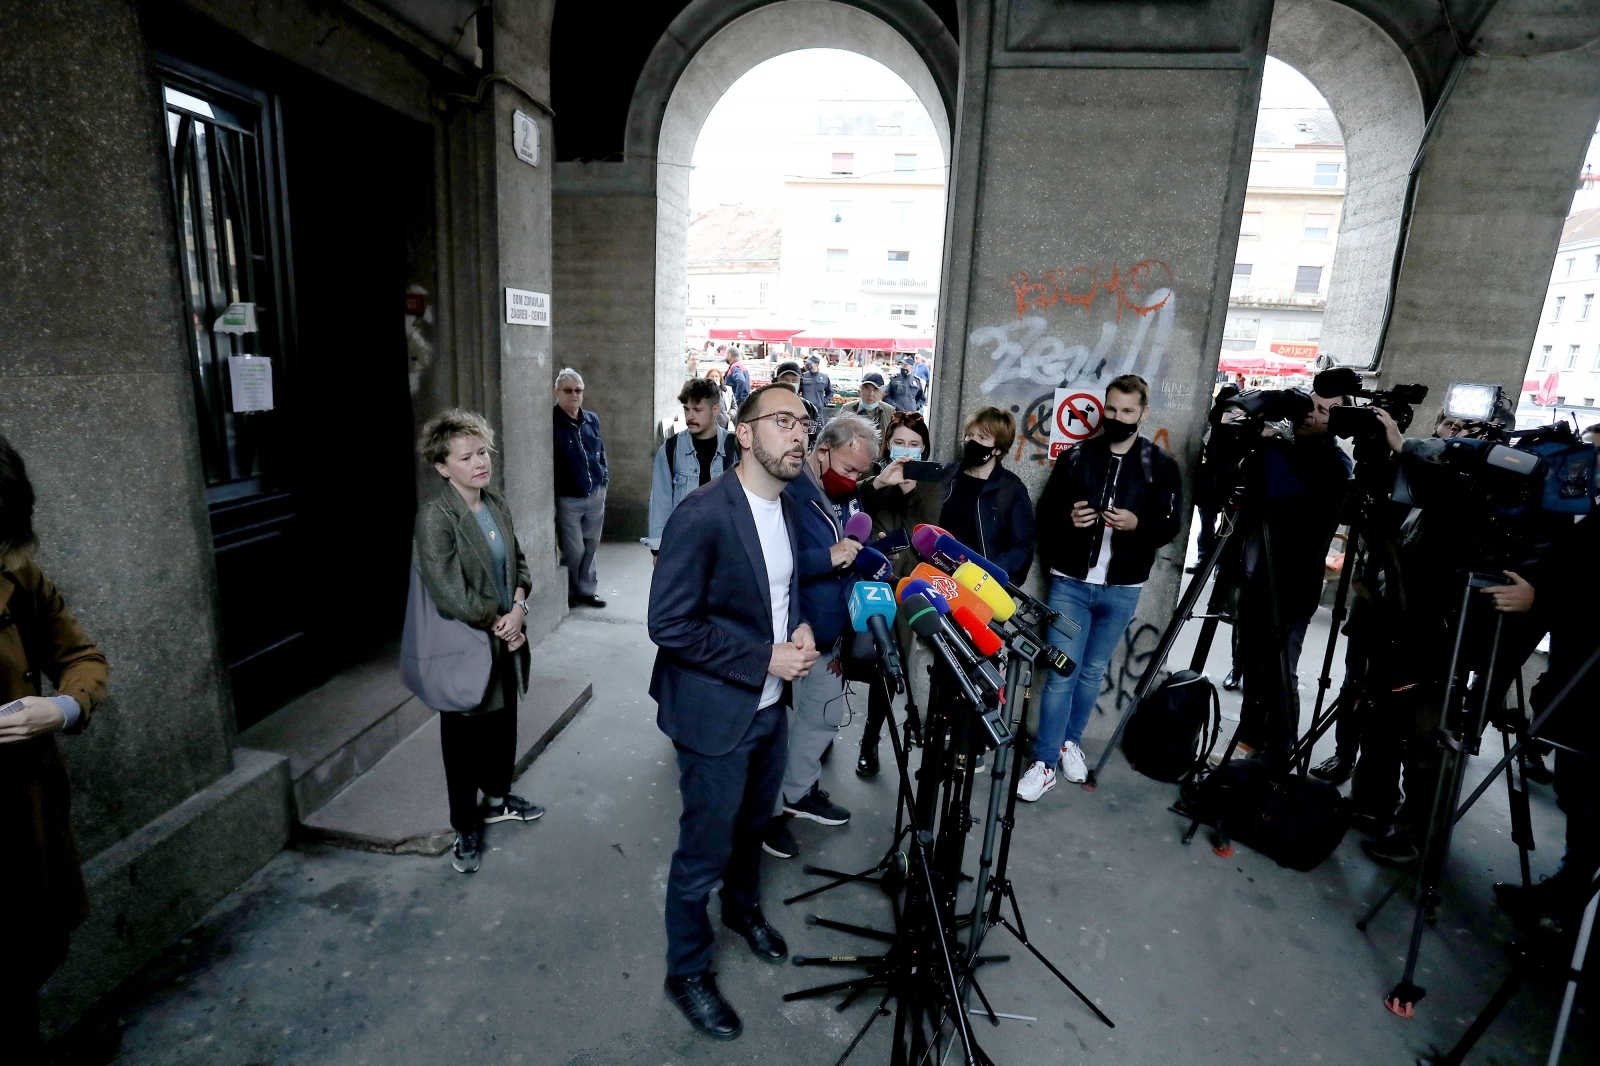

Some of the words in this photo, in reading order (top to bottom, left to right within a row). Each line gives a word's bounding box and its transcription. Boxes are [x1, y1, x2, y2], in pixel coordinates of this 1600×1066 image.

[521, 120, 531, 151] 2
[513, 294, 522, 305] DOM
[524, 296, 544, 307] ZDRAVLJA
[511, 308, 527, 319] ZAGREB
[531, 310, 546, 321] CENTAR
[931, 552, 951, 572] Laganini
[863, 586, 892, 602] Z1
